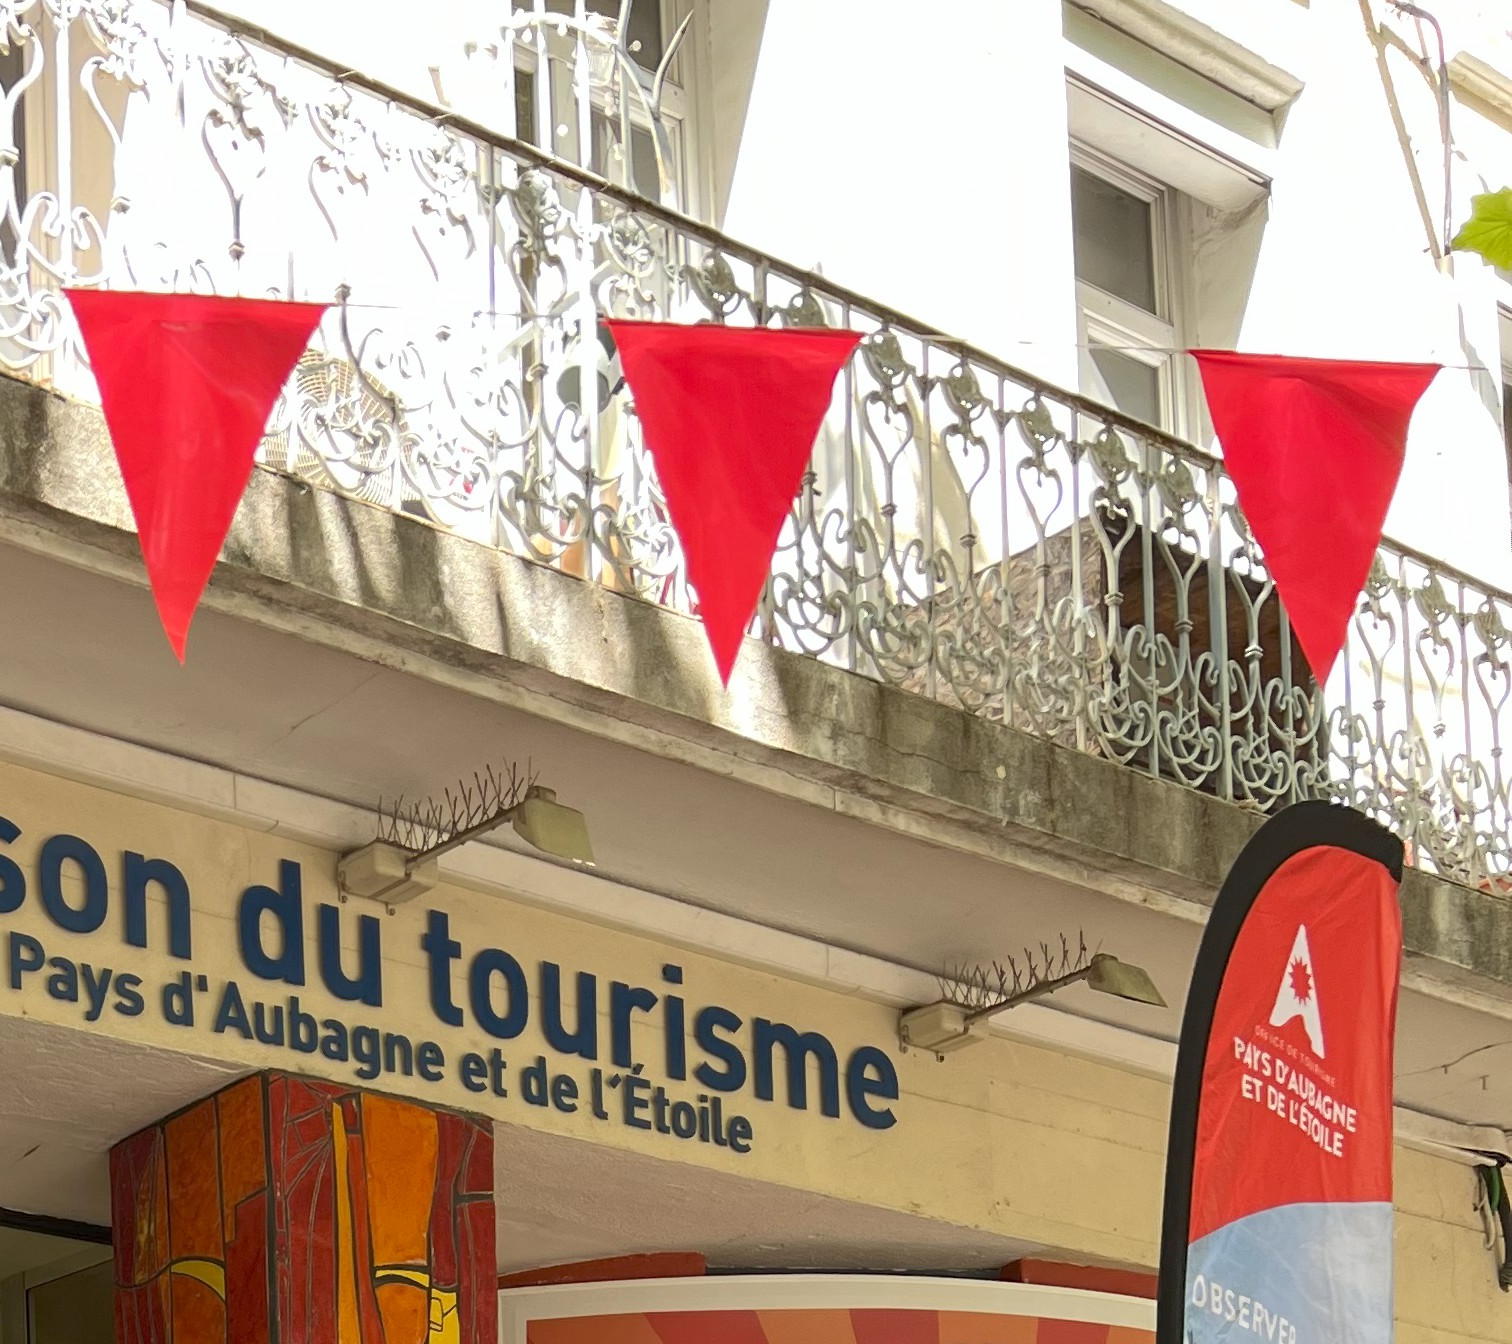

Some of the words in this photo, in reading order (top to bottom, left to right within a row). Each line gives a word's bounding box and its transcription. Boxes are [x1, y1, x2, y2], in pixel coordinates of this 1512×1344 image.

[7, 931, 146, 1023] Pays
[161, 969, 447, 1087] d'Aubagne
[458, 1043, 510, 1100] et
[518, 1055, 579, 1112] de
[587, 1063, 755, 1155] l'Étoile
[237, 857, 385, 1008] du
[420, 908, 900, 1131] tourisme
[1233, 1036, 1272, 1077] PAYS
[1275, 1058, 1357, 1133] D'AUBAGNE
[1241, 1073, 1263, 1103] ET
[1267, 1084, 1286, 1119] DE
[1289, 1100, 1344, 1158] L'ÉTOILE
